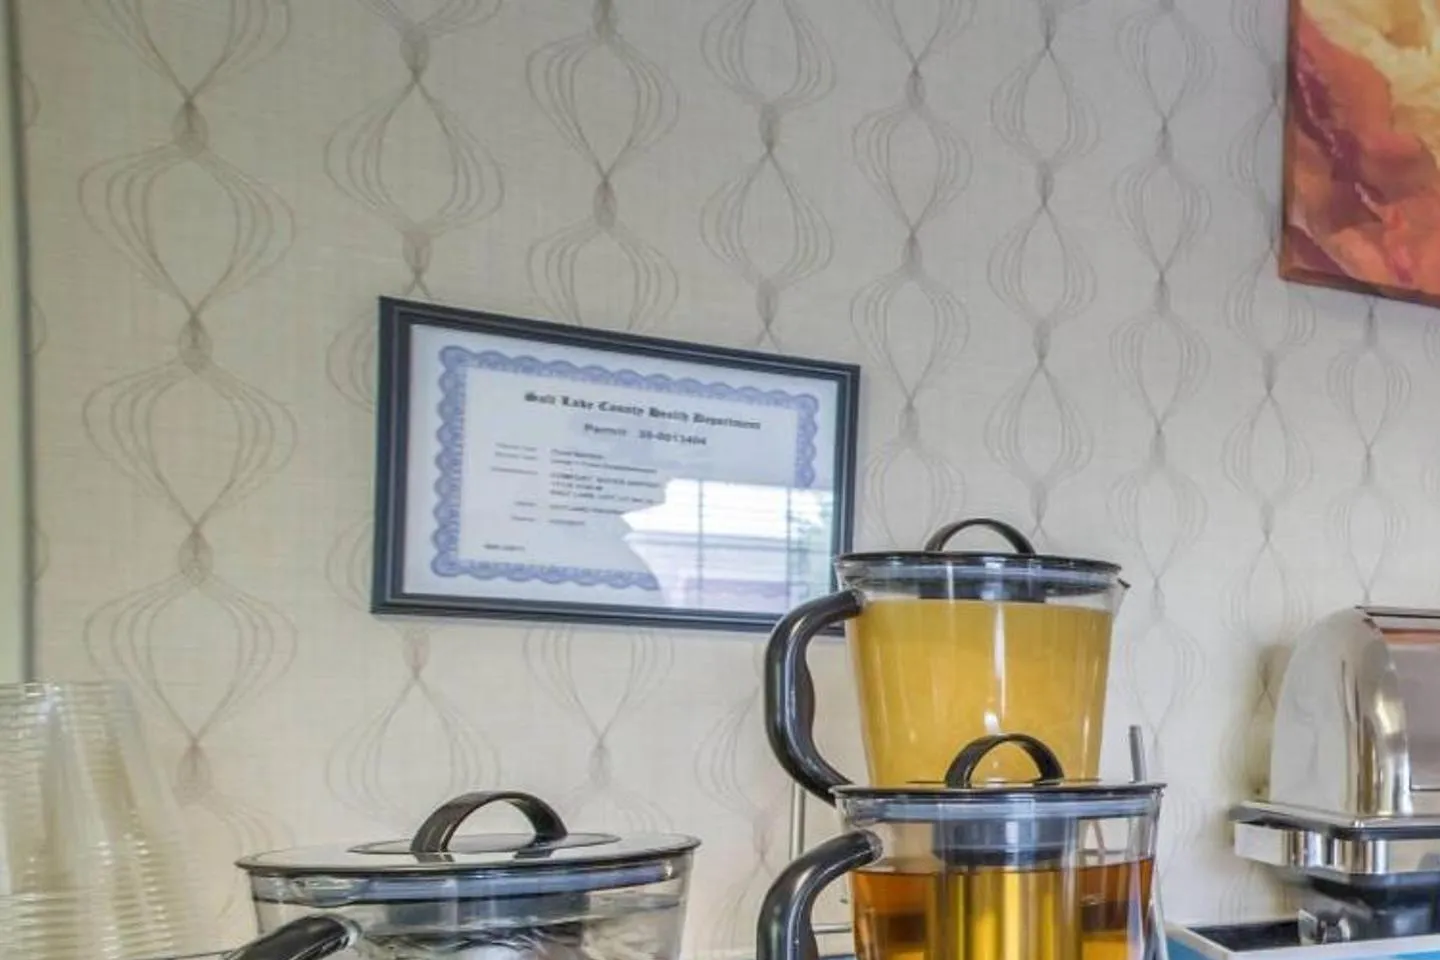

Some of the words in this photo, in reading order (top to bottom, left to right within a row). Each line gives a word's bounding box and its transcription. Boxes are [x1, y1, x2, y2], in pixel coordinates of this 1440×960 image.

[562, 396, 594, 410] Lake
[598, 400, 645, 416] County
[649, 406, 689, 422] Health
[692, 412, 762, 430] Department
